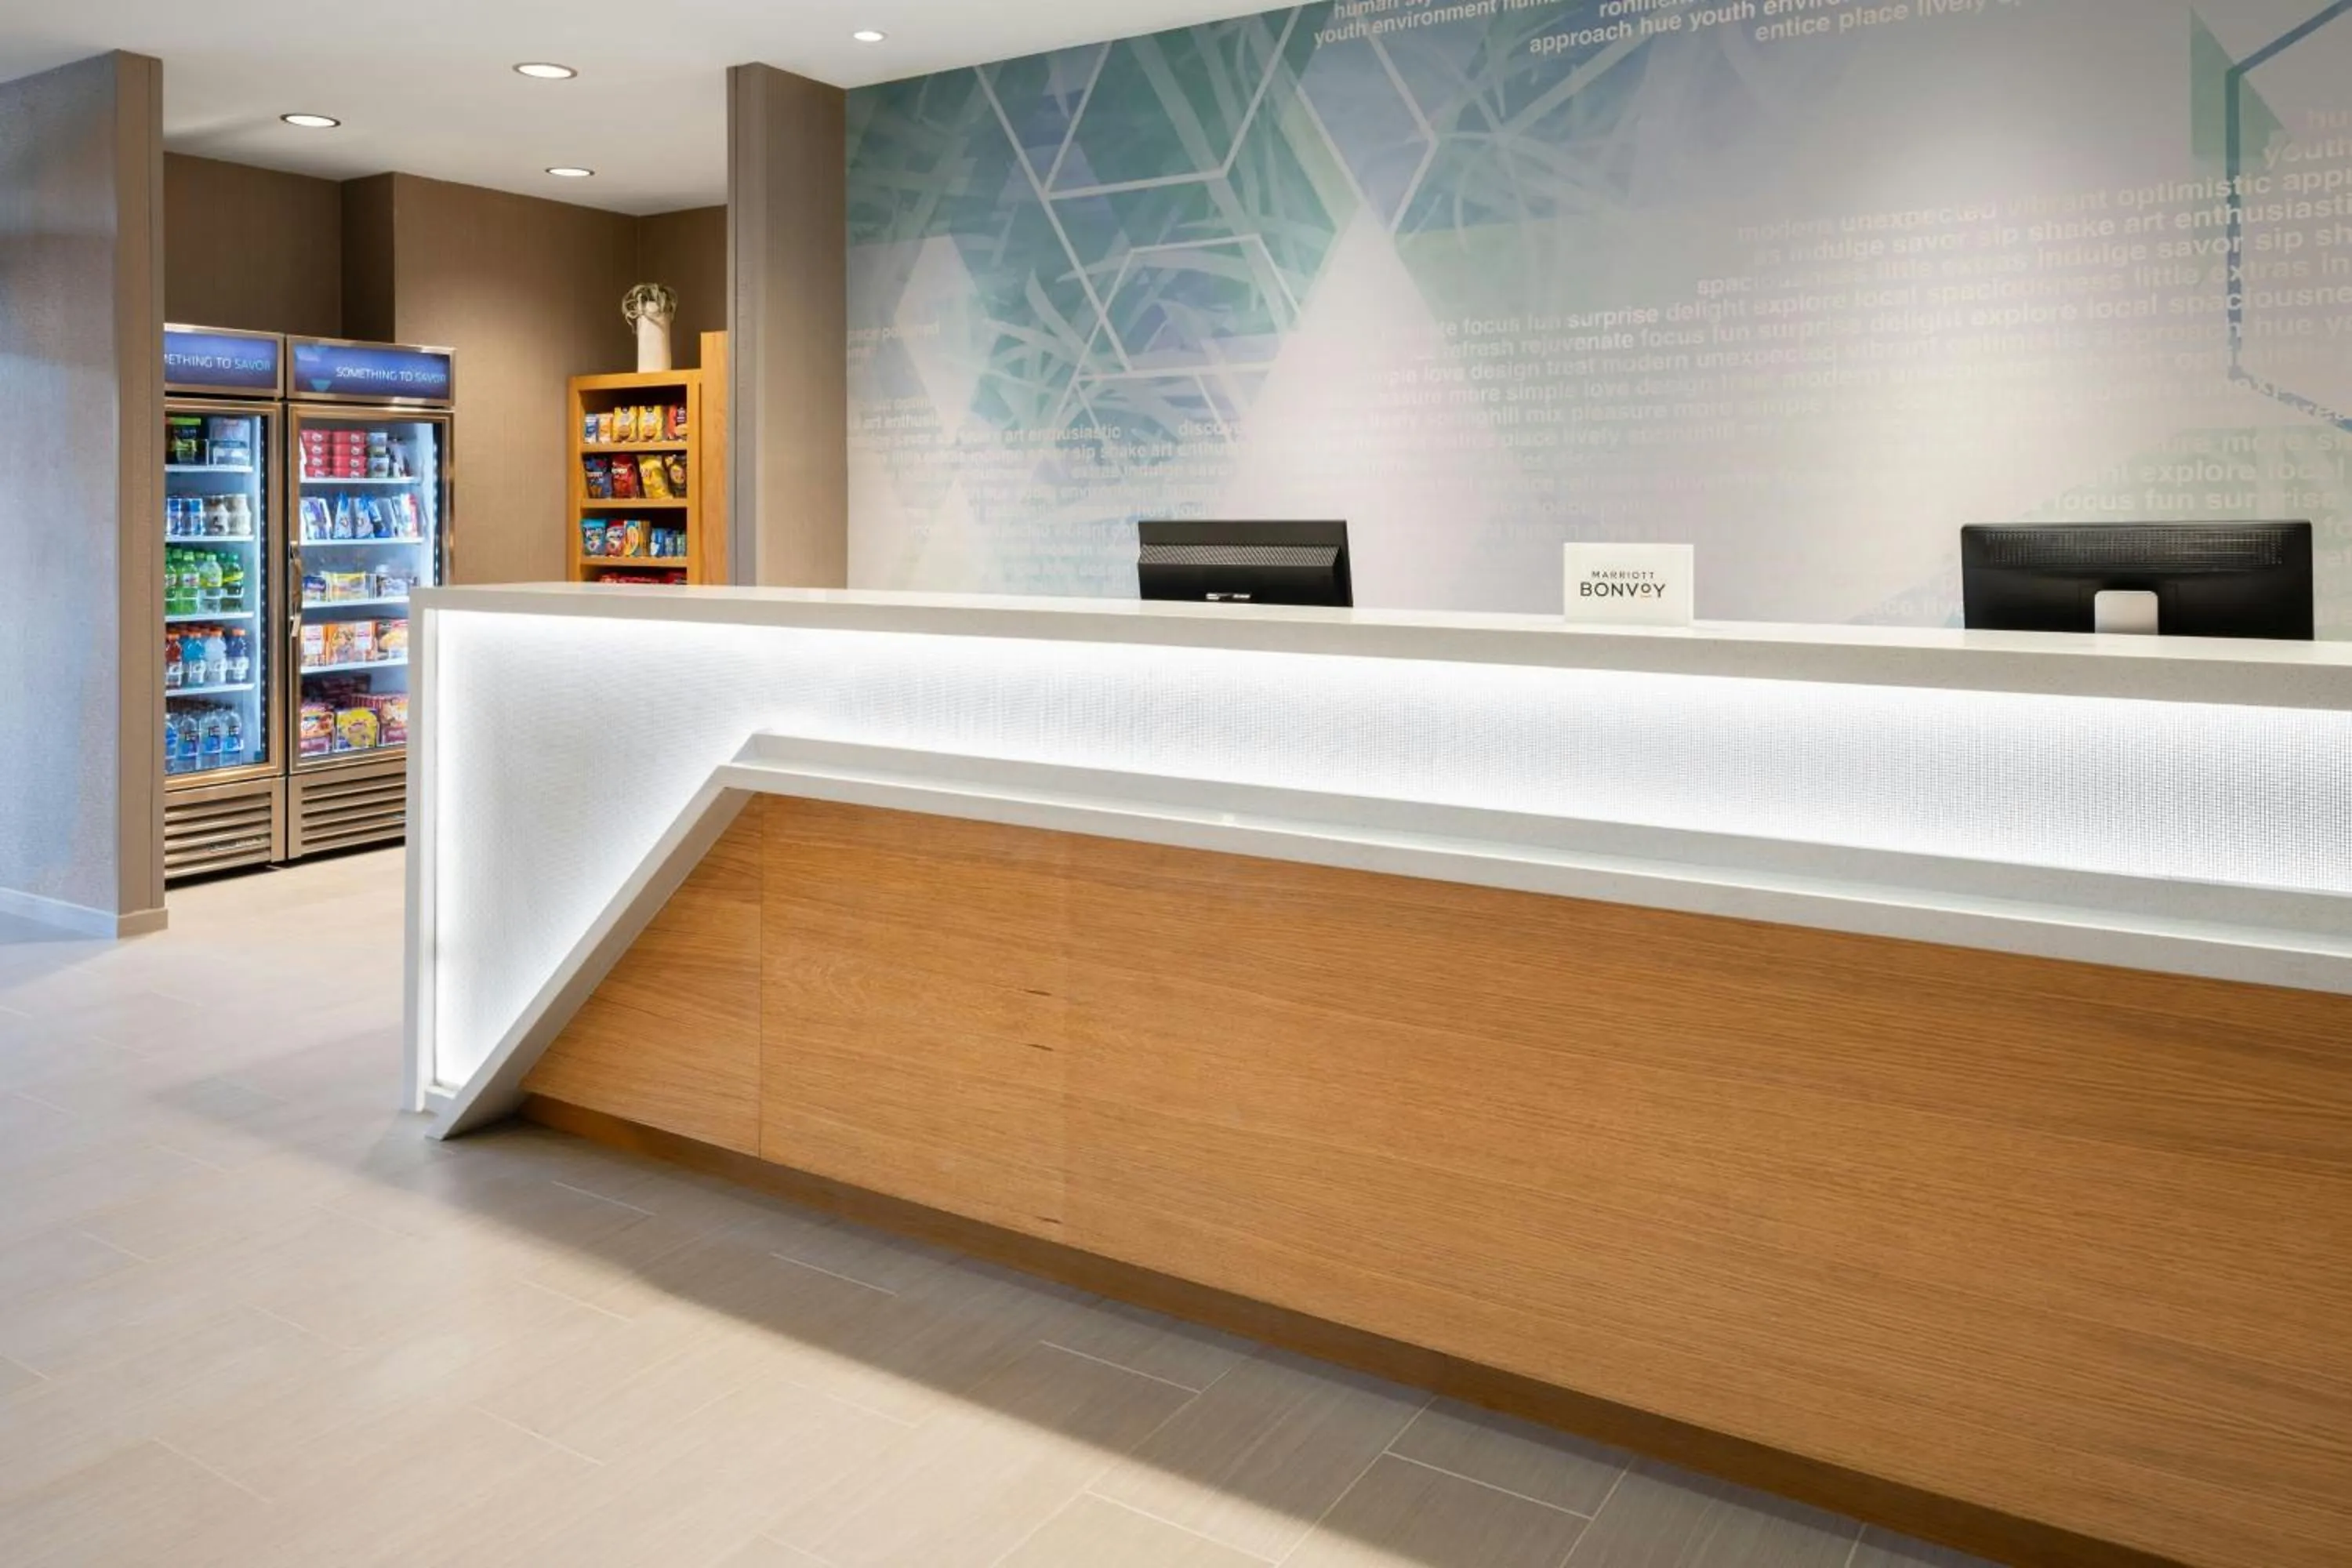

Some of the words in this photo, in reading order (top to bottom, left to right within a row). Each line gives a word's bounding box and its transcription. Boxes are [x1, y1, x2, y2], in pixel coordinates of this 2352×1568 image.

[1314, 17, 1367, 49] youth
[1373, 0, 1496, 33] environment
[1530, 20, 1632, 53] approach
[1640, 13, 1682, 34] hue
[1690, 0, 1755, 32] youth
[1755, 16, 1831, 41] entice
[1838, 3, 1908, 34] place
[2118, 172, 2272, 210] optimistic
[1790, 235, 1885, 261] indulge
[2028, 217, 2115, 241] shake
[2125, 212, 2165, 234] art
[2038, 241, 2147, 270] indulge
[2158, 235, 2245, 260] savor
[2255, 227, 2304, 255] sip
[1520, 332, 1635, 358] rejuvenate
[1641, 327, 1705, 347] focus
[1713, 324, 1750, 344] fun
[1971, 300, 2077, 330] explore
[2087, 292, 2158, 319] local
[1567, 305, 1659, 330] surprise
[1665, 297, 1747, 323] delight
[2255, 315, 2314, 336] hue
[216, 357, 231, 369] TO
[336, 366, 397, 381] SOMETHING
[399, 371, 413, 383] TO
[2140, 458, 2256, 488] explore
[2145, 487, 2194, 511] fun
[1580, 581, 1666, 598] BONVOY
[1591, 571, 1654, 579] MARRIOTT
